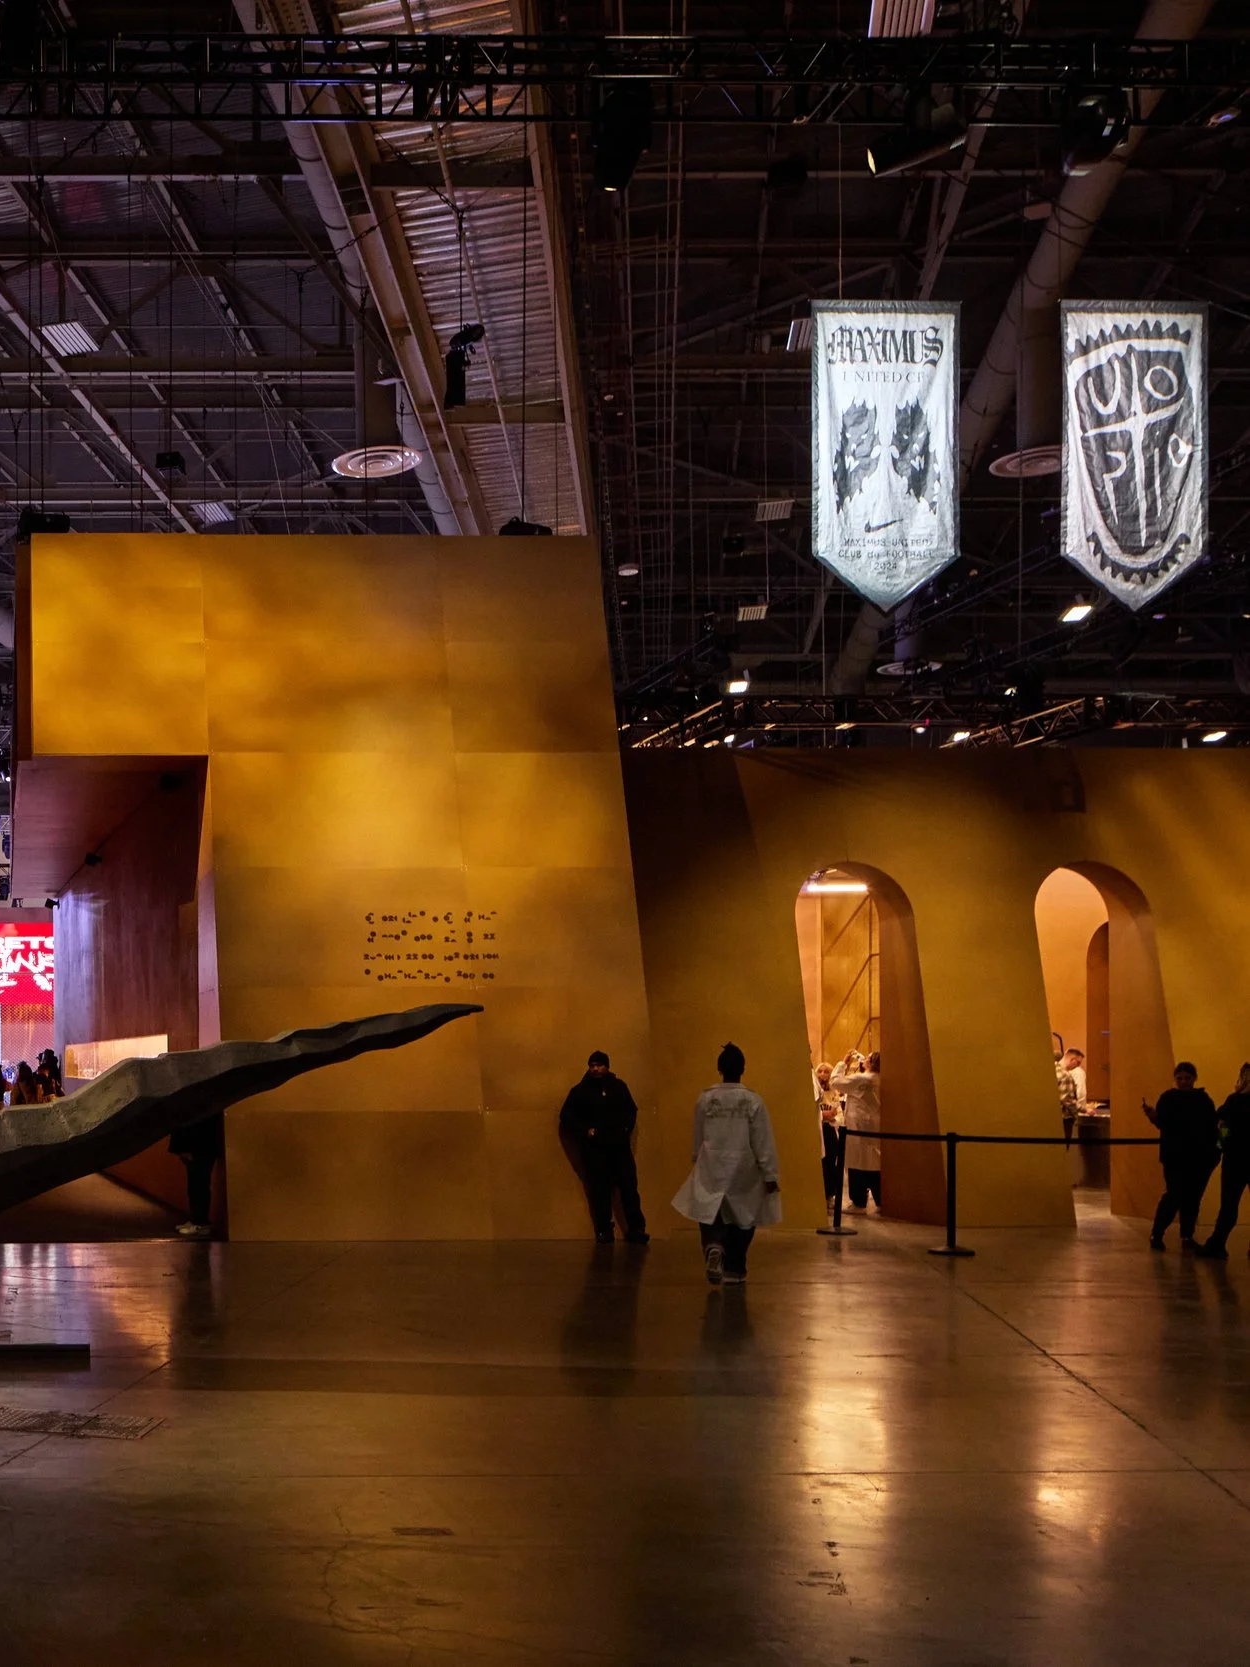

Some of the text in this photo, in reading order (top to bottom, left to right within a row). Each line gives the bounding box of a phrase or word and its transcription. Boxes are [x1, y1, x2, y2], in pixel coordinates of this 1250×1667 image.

[828, 326, 944, 368] MAXIMUS
[843, 371, 902, 383] UNITED
[838, 549, 862, 559] CLUB
